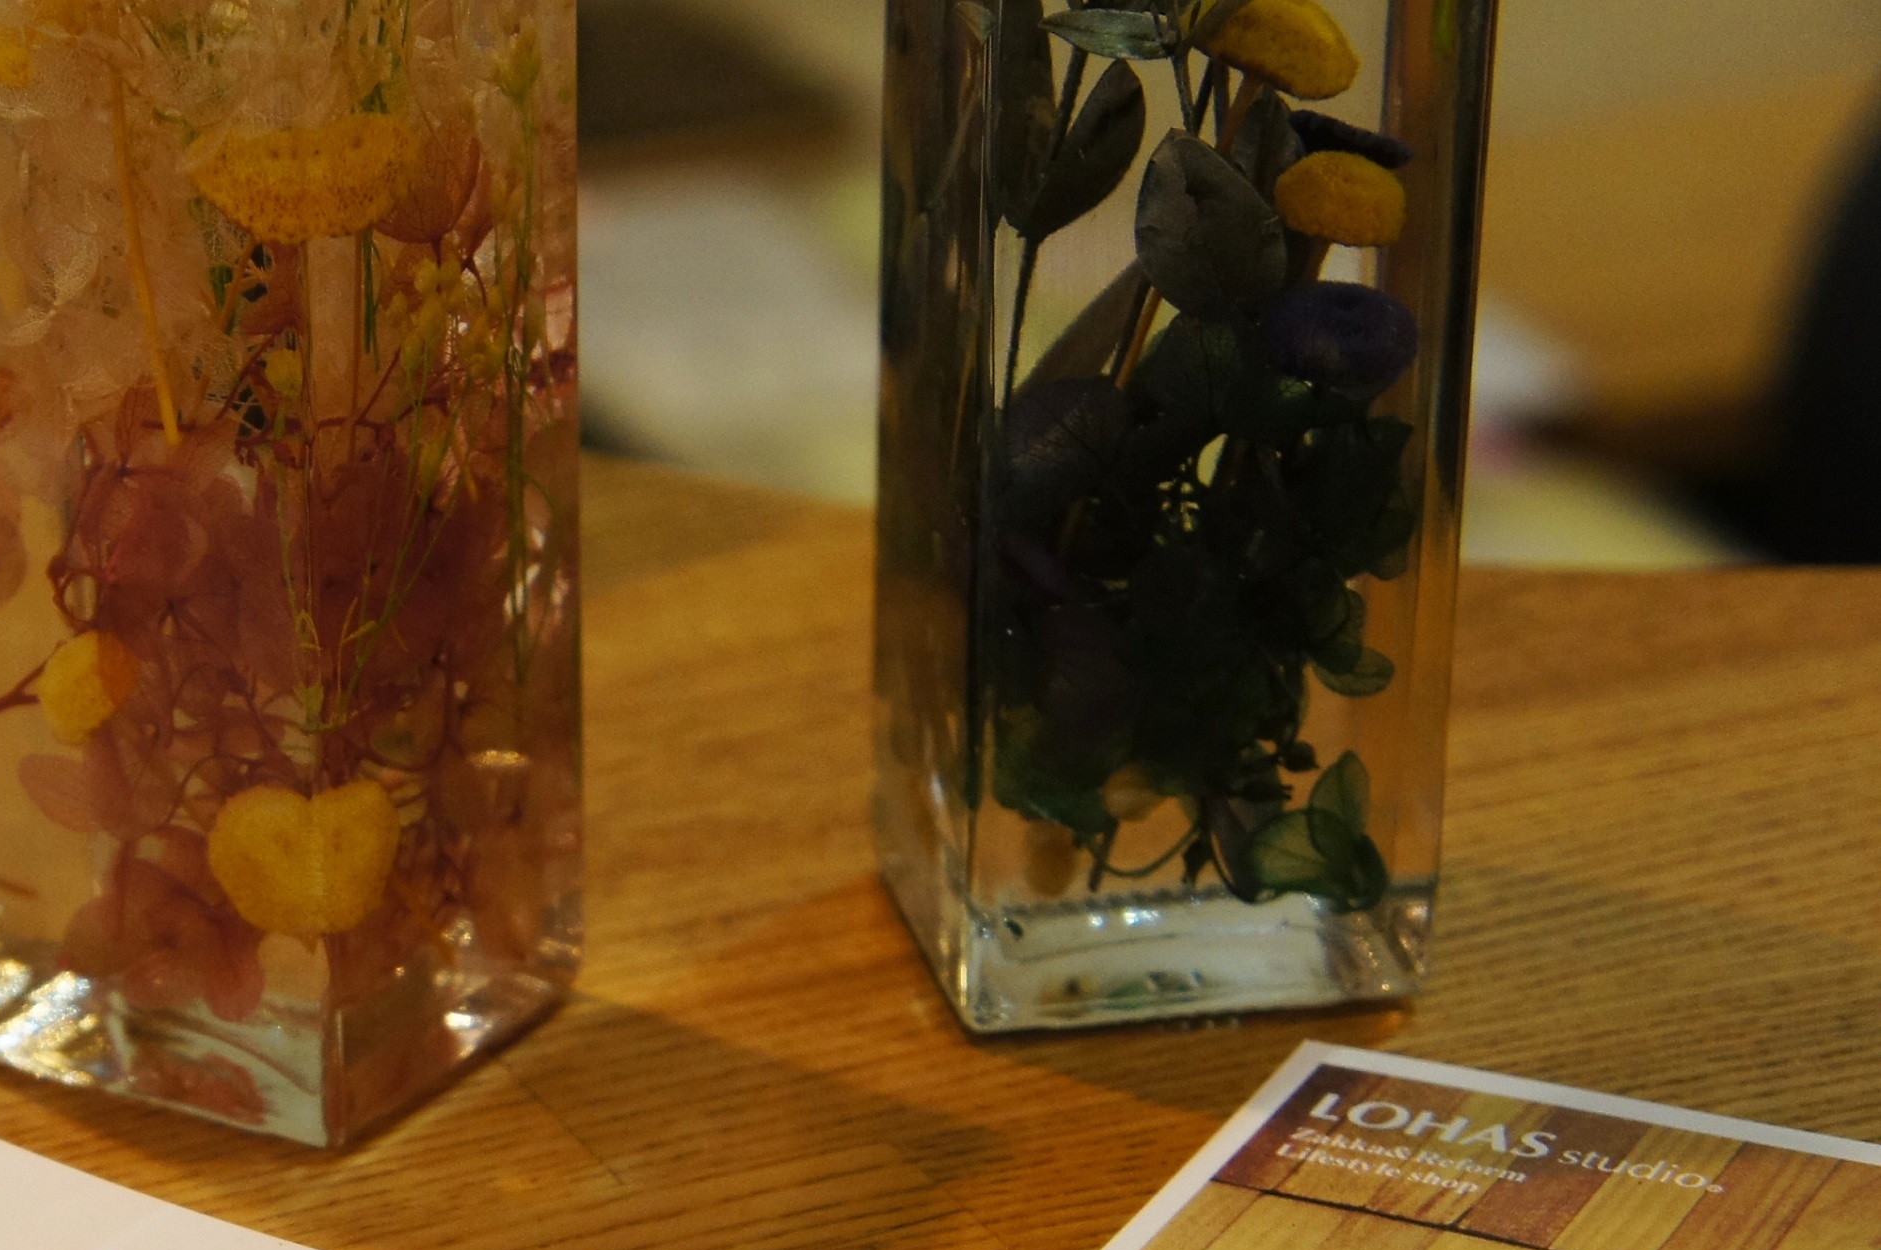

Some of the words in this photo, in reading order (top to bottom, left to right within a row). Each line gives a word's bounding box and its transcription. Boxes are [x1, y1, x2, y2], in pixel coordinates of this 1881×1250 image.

[1308, 1091, 1558, 1159] LOHAS
[1274, 1142, 1402, 1180] Lifestyle
[1407, 1170, 1481, 1195] shop
